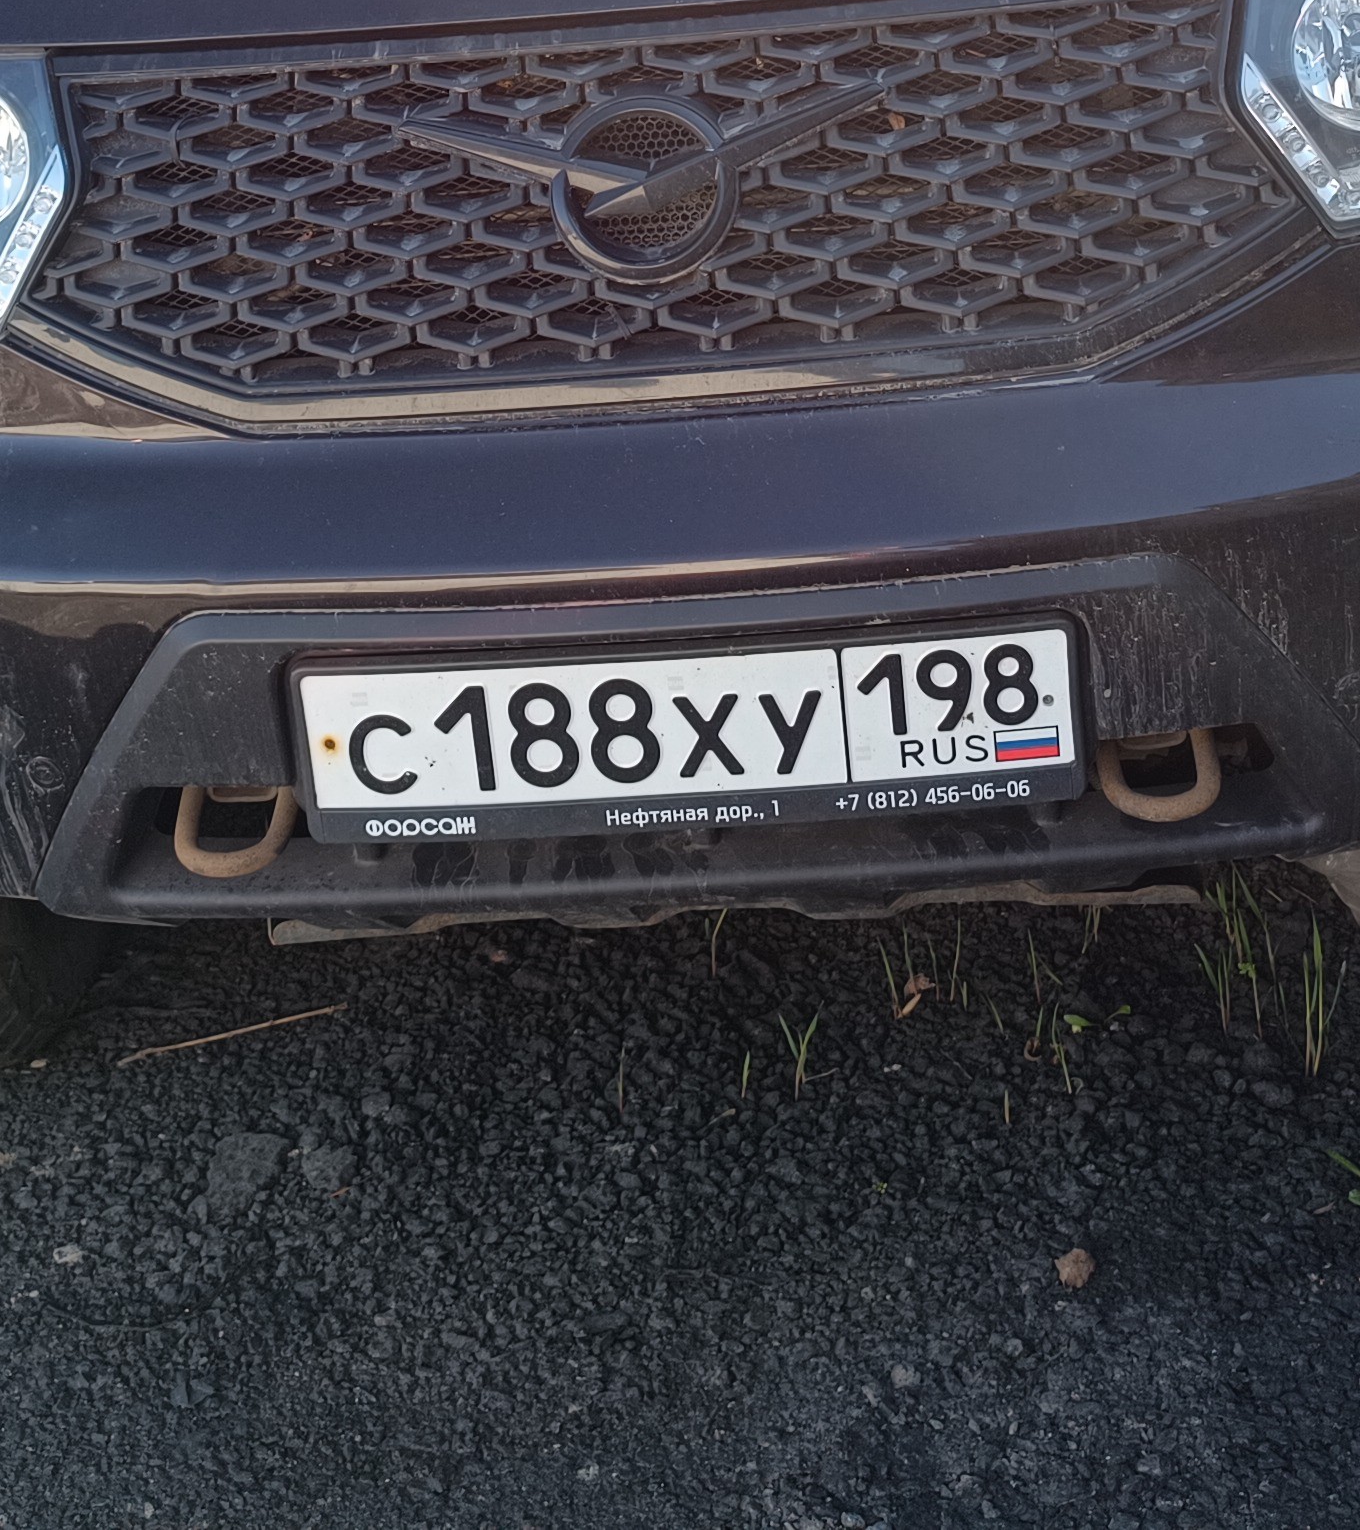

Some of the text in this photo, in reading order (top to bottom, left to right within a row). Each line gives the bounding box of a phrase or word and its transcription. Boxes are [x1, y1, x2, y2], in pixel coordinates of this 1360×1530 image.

[856, 643, 1039, 736] 198
[899, 735, 989, 769] RUS
[835, 779, 1031, 811] +7 (812) 456-06-06
[605, 799, 780, 828] Нефтяная дор., 1
